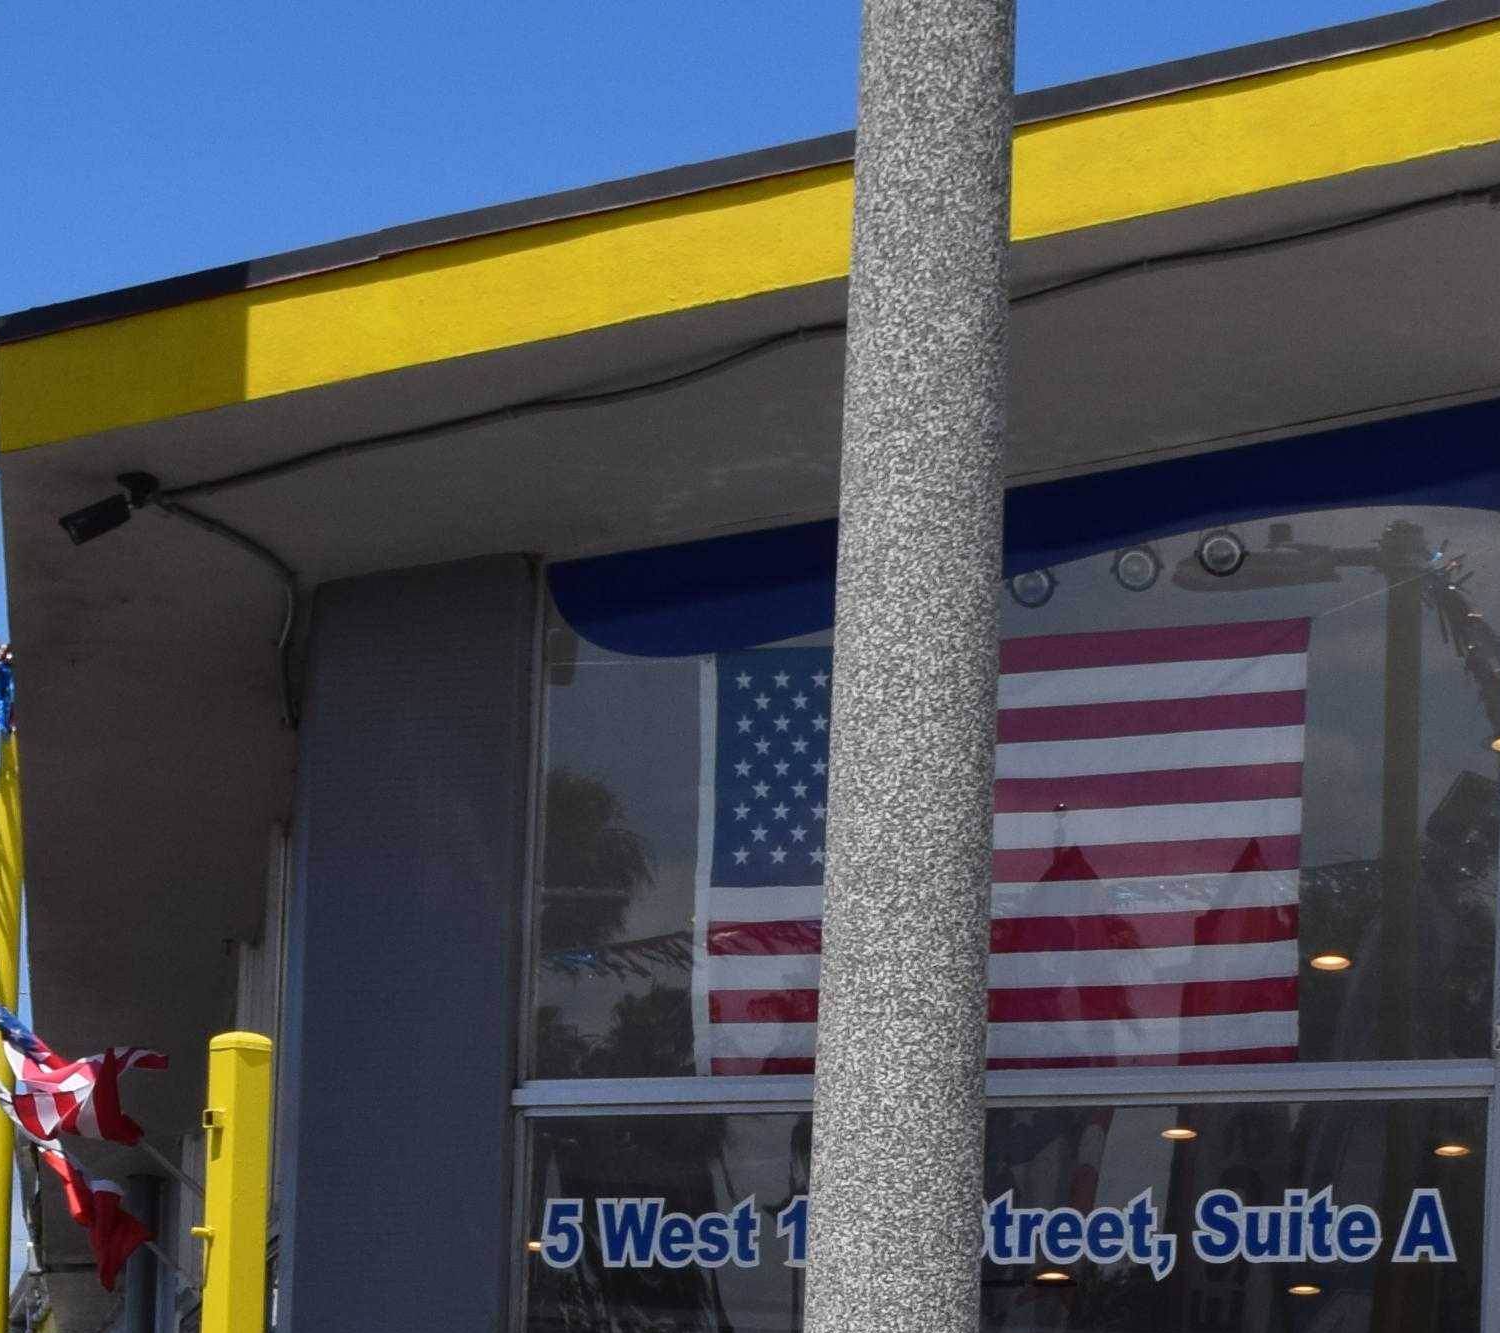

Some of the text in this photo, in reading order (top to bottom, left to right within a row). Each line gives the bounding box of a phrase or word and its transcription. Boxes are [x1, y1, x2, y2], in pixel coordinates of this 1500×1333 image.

[541, 1198, 583, 1268] 5
[596, 1194, 760, 1268] West
[982, 1184, 1457, 1282] treet, Suite A
